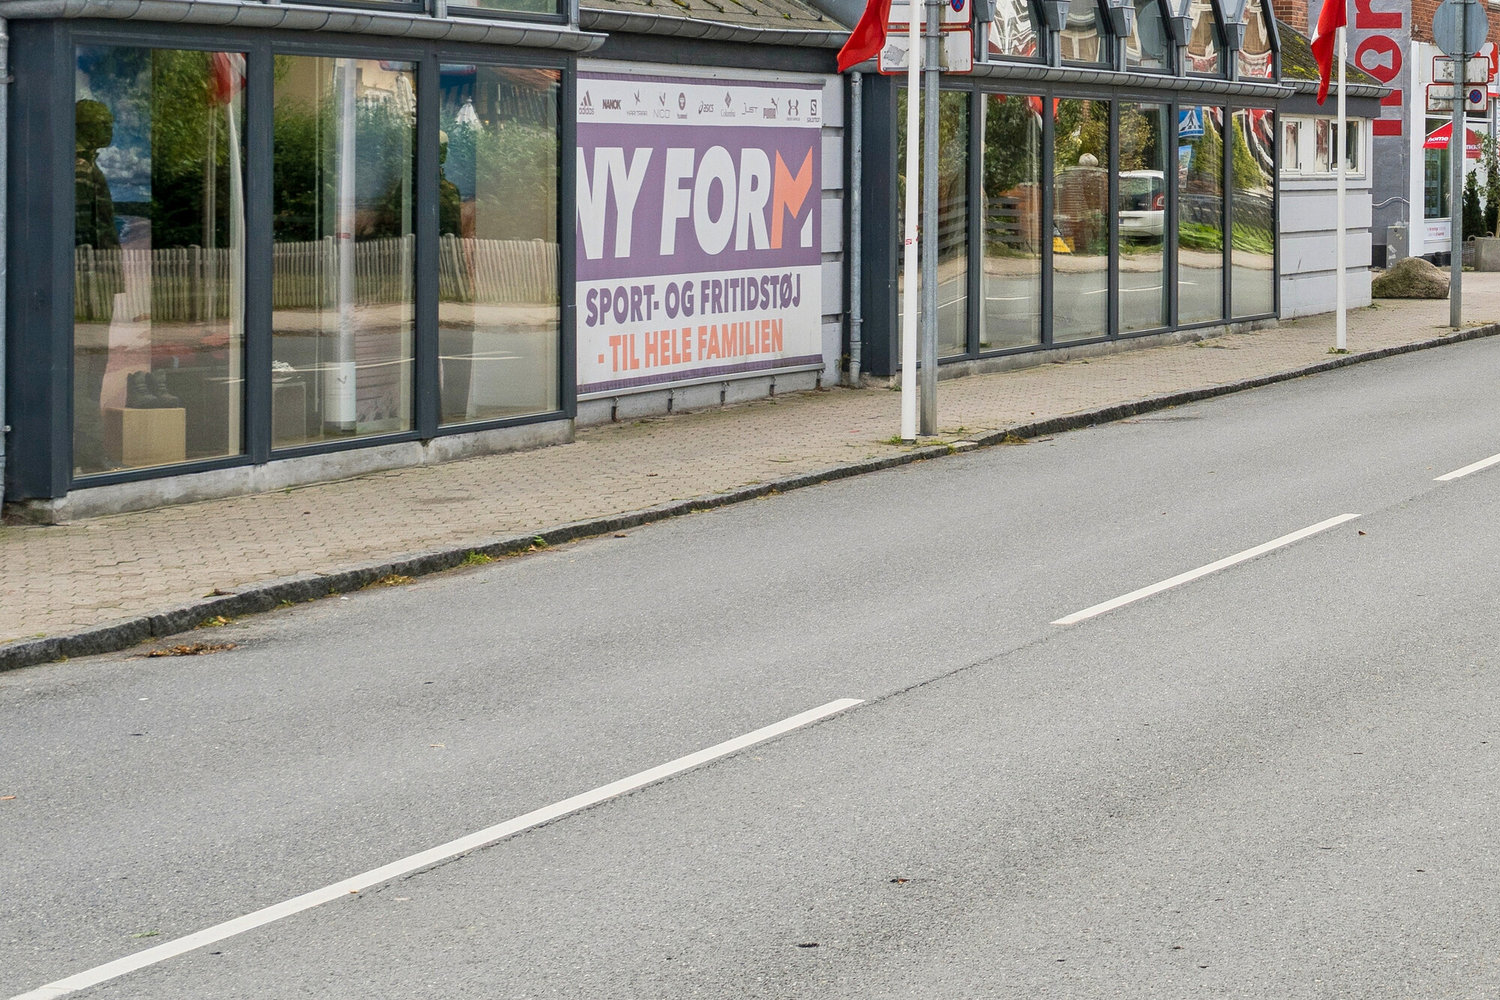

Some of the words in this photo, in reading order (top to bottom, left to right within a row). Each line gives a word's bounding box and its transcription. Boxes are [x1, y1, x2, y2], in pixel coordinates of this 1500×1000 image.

[577, 147, 654, 260] NY
[660, 145, 813, 257] FORM
[585, 285, 660, 327] SPORT-
[665, 281, 695, 320] OG
[701, 271, 800, 315] FRITIDSTØJ
[609, 333, 640, 372] TIL
[645, 327, 692, 368] HELE
[697, 318, 784, 360] FAMILIEN
